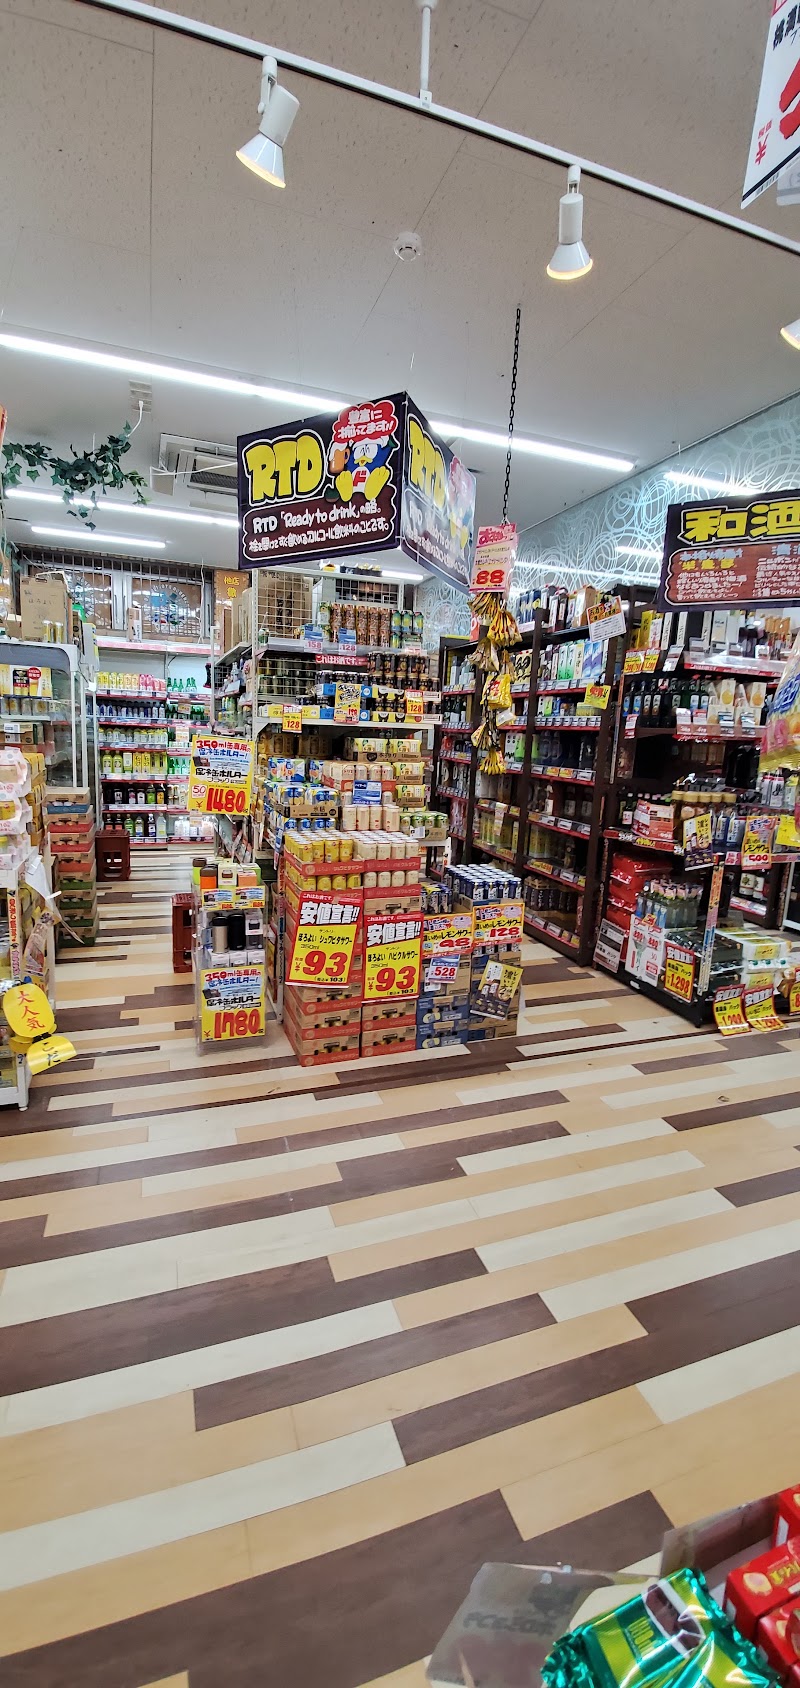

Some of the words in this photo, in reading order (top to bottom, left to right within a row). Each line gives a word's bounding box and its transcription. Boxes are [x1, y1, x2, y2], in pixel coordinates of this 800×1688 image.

[347, 409, 384, 425] 豊富に
[245, 434, 324, 502] RTD
[410, 420, 447, 508] RTD
[353, 470, 368, 487] ド
[253, 516, 278, 535] RTD
[317, 508, 327, 523] to
[683, 500, 800, 543] 和酒
[475, 569, 505, 585] 88
[409, 704, 422, 713] 128
[286, 720, 300, 729] 128
[195, 800, 204, 809] ¥
[206, 787, 246, 814] 1480
[748, 854, 769, 863] 500
[302, 893, 333, 901] これはお酒です。
[300, 901, 361, 925] 安値宣言!!
[298, 933, 317, 943] ほろよい
[366, 921, 421, 946] 安値宣言!!
[489, 926, 520, 938] 128
[438, 937, 471, 948] 98
[303, 950, 348, 977] 93
[367, 953, 386, 963] ほろよい
[375, 965, 417, 992] 93
[434, 966, 456, 977] 528
[18, 991, 45, 1031] 大人気
[213, 1009, 261, 1039] 1780
